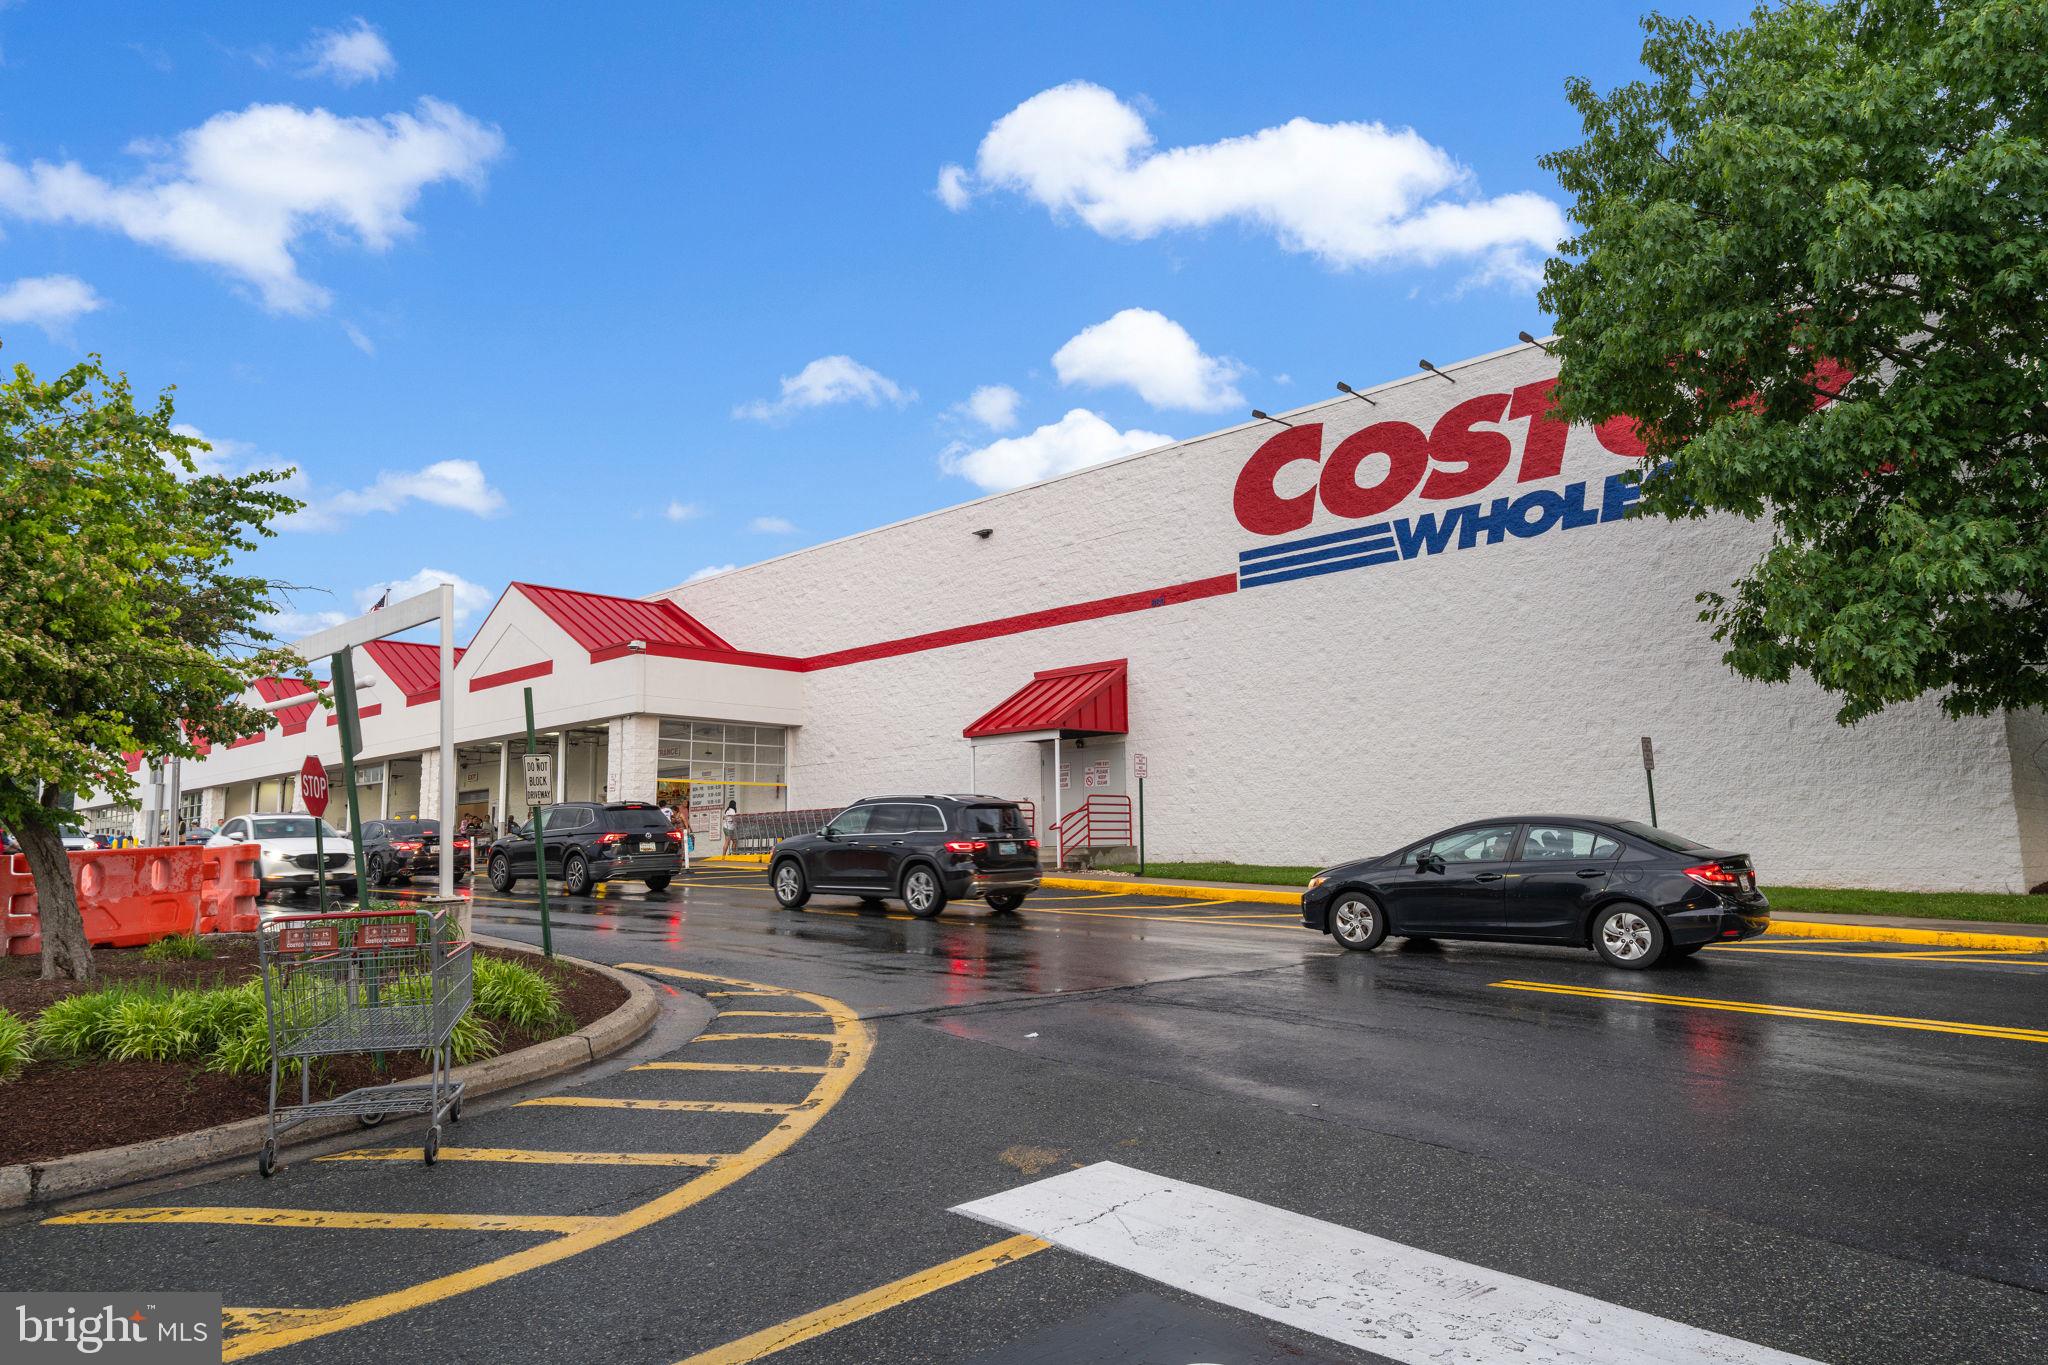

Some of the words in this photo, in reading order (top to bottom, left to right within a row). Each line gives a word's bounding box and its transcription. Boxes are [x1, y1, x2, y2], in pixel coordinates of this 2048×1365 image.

[527, 761, 535, 772] DO
[536, 761, 548, 772] NOT
[302, 774, 327, 799] STOP
[529, 776, 548, 787] BLOCK
[527, 790, 551, 800] DRIVEWAY
